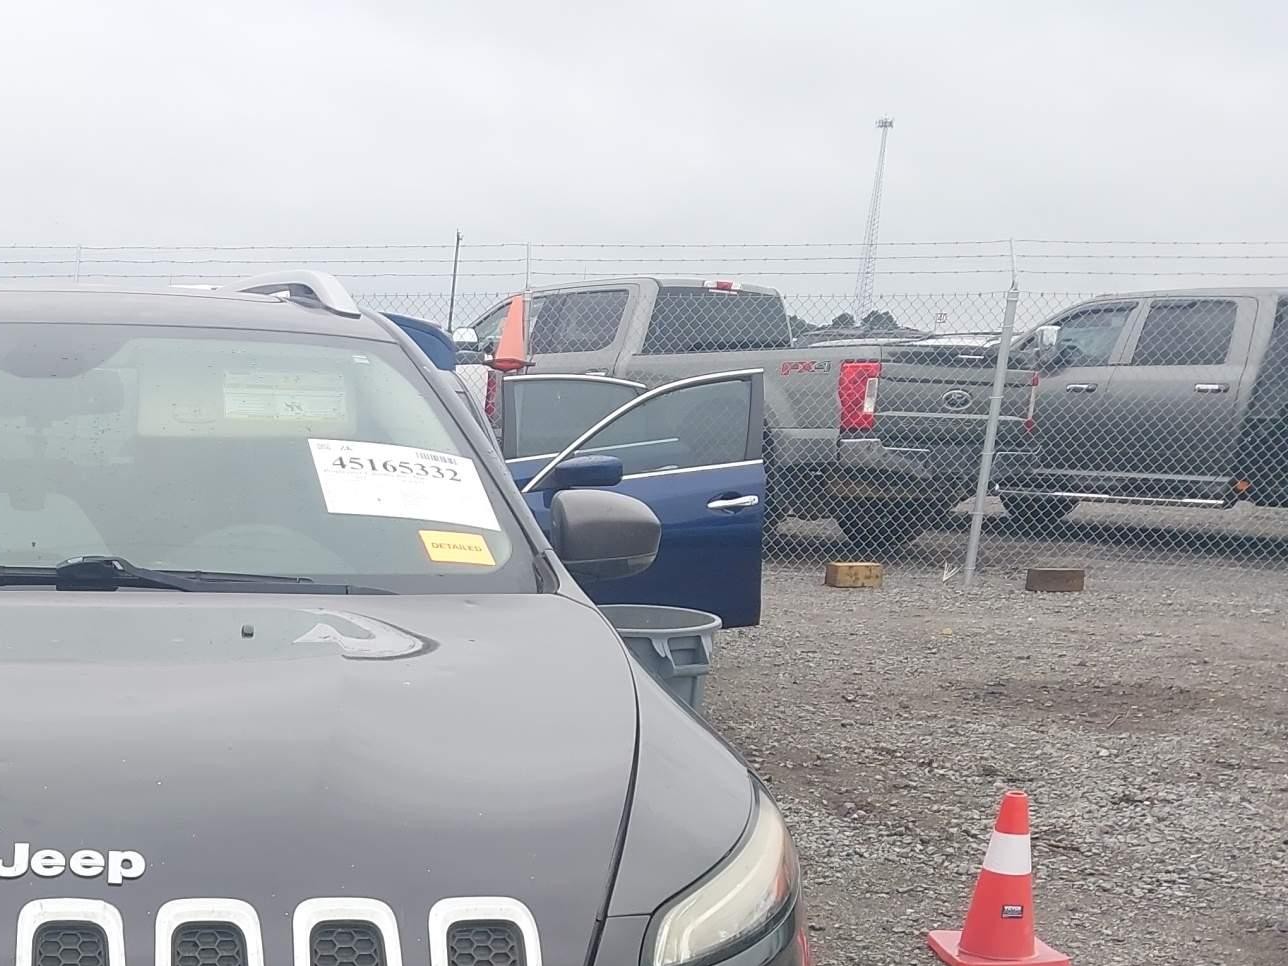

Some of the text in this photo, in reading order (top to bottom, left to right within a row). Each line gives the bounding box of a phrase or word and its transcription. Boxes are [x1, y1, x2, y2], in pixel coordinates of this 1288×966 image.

[780, 360, 832, 376] FX4
[332, 456, 462, 482] 45165332
[431, 541, 483, 553] DETAILED
